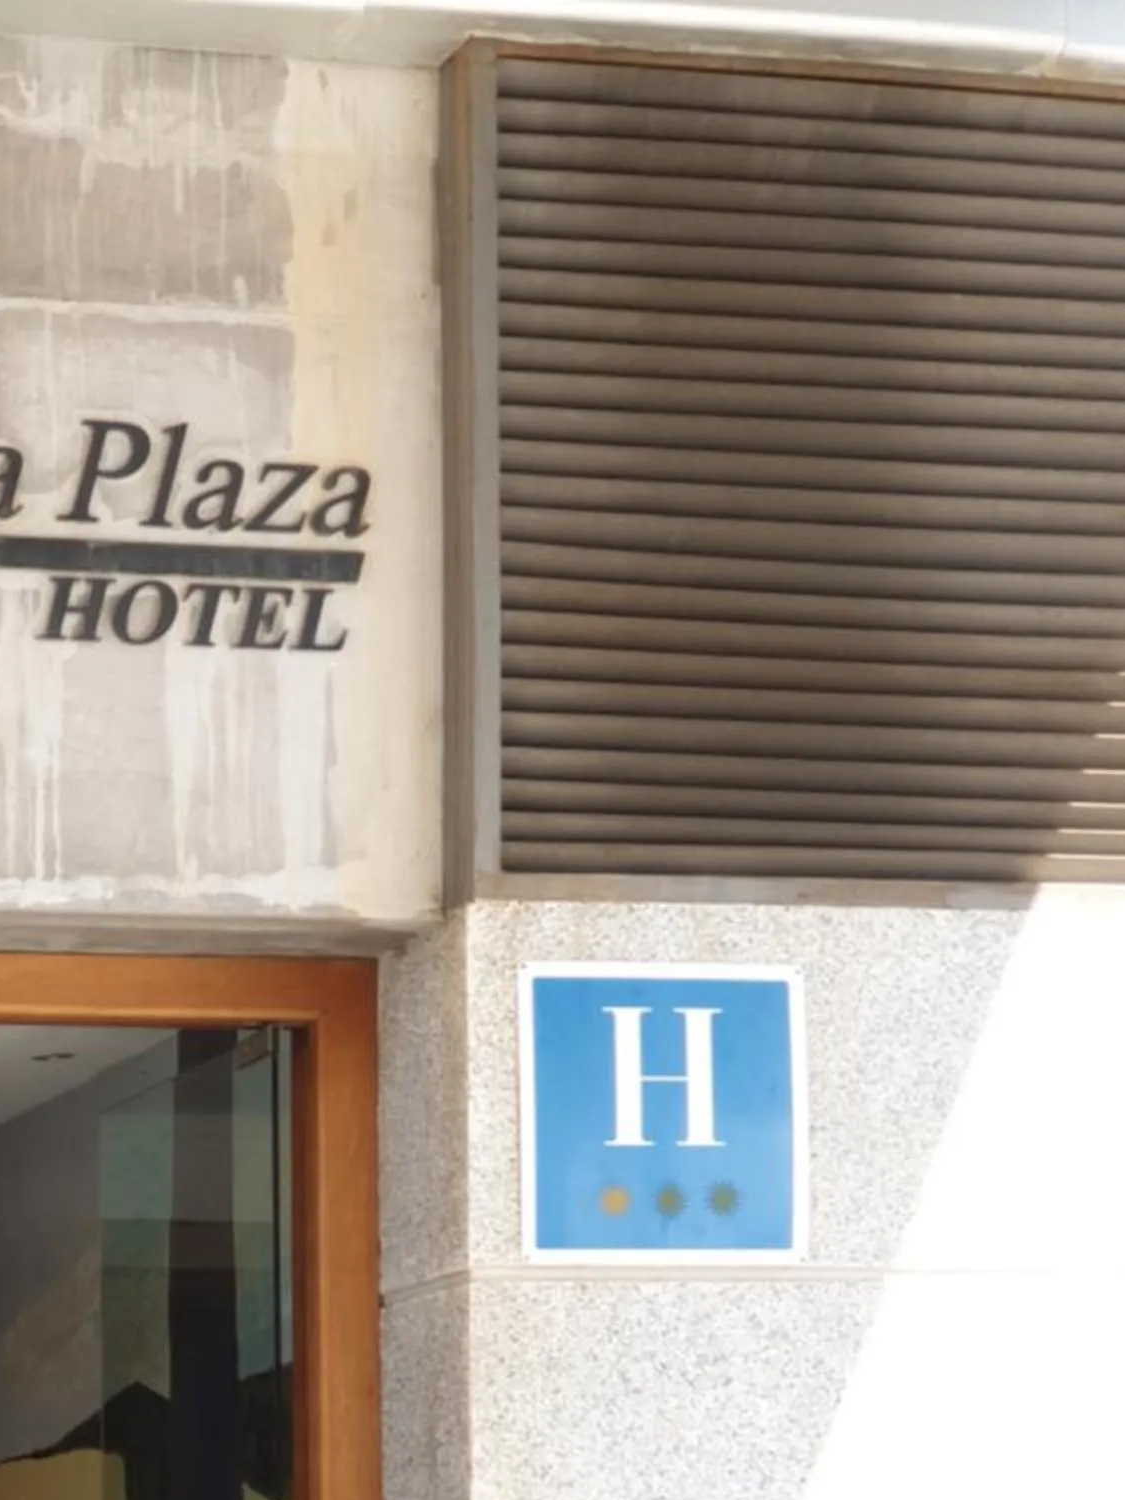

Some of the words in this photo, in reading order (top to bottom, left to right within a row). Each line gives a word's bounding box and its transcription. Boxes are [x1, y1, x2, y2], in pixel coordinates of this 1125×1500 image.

[56, 418, 373, 539] Plaza
[35, 575, 349, 652] HOTEL
[601, 1005, 727, 1147] H
